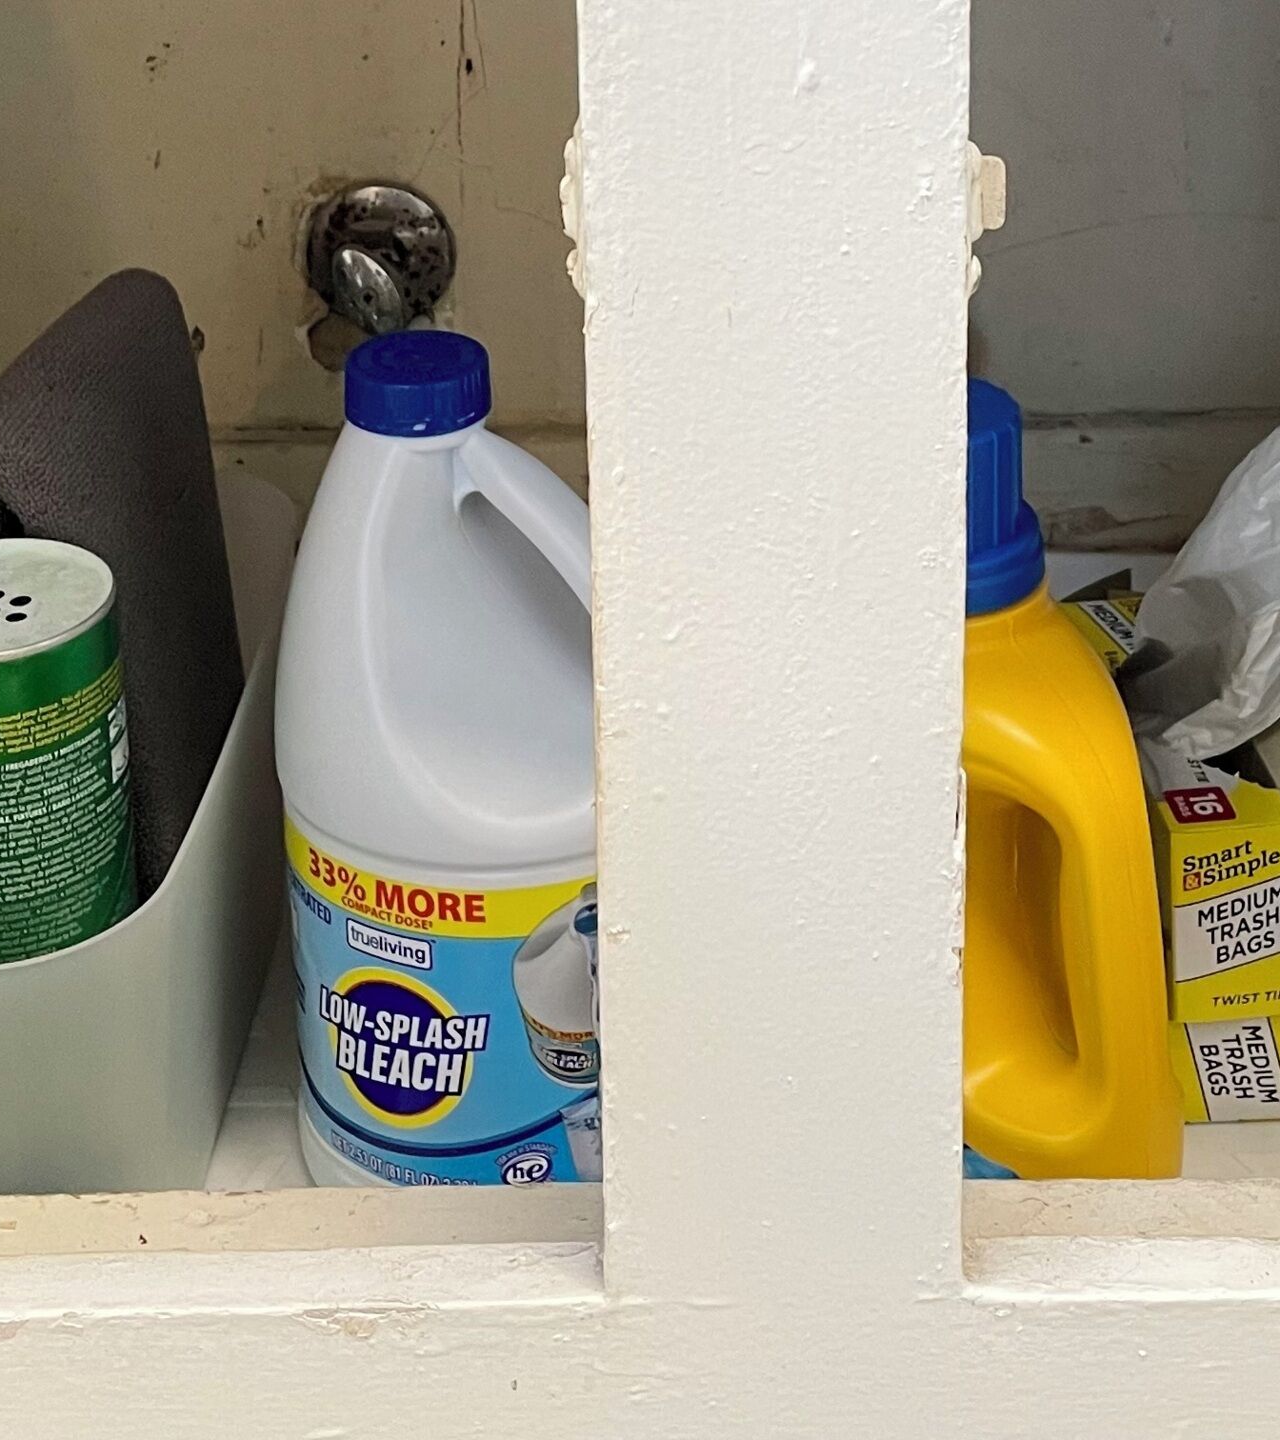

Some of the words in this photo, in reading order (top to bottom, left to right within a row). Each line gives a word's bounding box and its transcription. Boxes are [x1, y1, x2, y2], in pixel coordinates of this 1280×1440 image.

[1189, 792, 1224, 816] 16
[1183, 840, 1253, 873] Smart
[309, 847, 367, 902] 33%
[375, 879, 486, 924] MORE
[341, 896, 392, 923] COMPACT
[1206, 907, 1280, 945] TRASH
[1216, 931, 1276, 964] BAGS
[1212, 992, 1260, 1008] TWIST
[320, 987, 488, 1050] LOW-SPLASH
[338, 1032, 464, 1093] BLEACH
[1199, 1044, 1230, 1096] BAGS
[1222, 1034, 1256, 1099] TRASH
[1242, 1026, 1280, 1103] MEDIUM
[404, 1168, 418, 1185] FL
[512, 1163, 544, 1179] he
